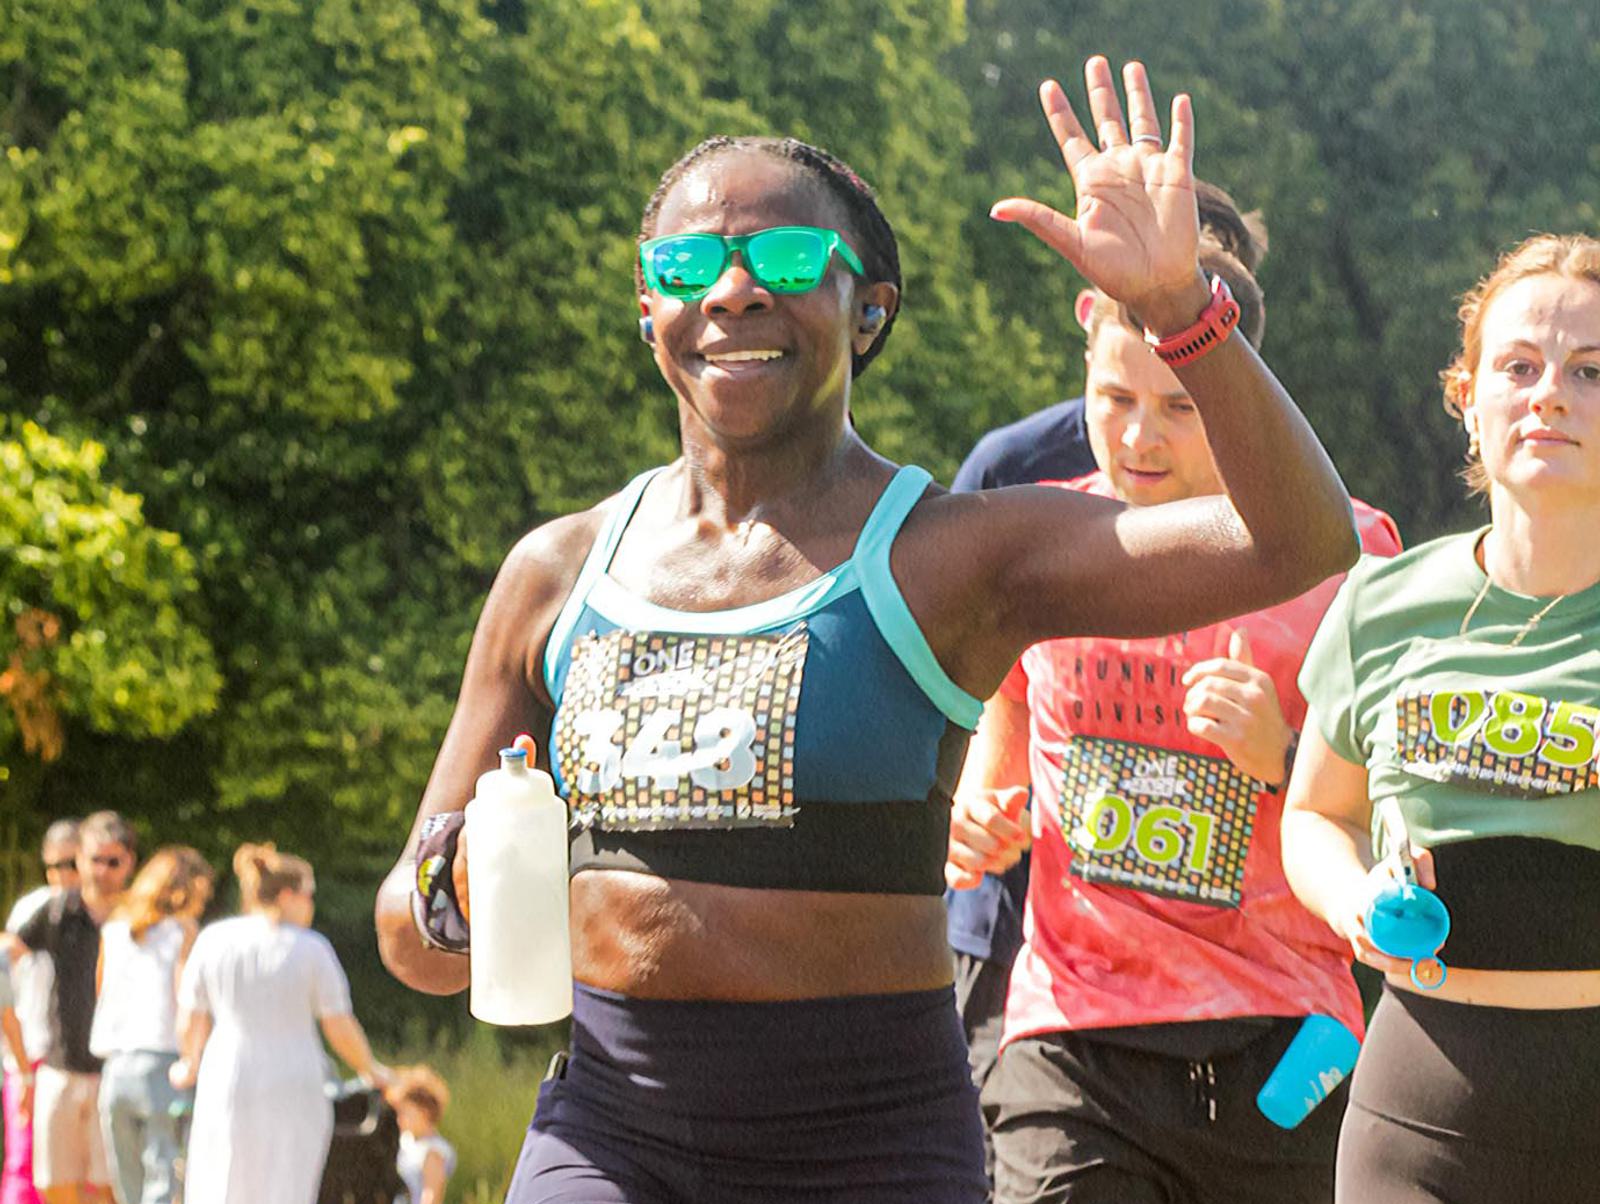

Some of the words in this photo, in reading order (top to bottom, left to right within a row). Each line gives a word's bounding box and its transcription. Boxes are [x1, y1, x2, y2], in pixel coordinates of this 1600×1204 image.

[634, 641, 695, 675] ONE
[1075, 657, 1177, 687] RUNNI
[1074, 700, 1181, 727] DIVISI
[1430, 690, 1600, 768] 085
[1134, 755, 1178, 777] ONE
[1084, 794, 1214, 873] 061
